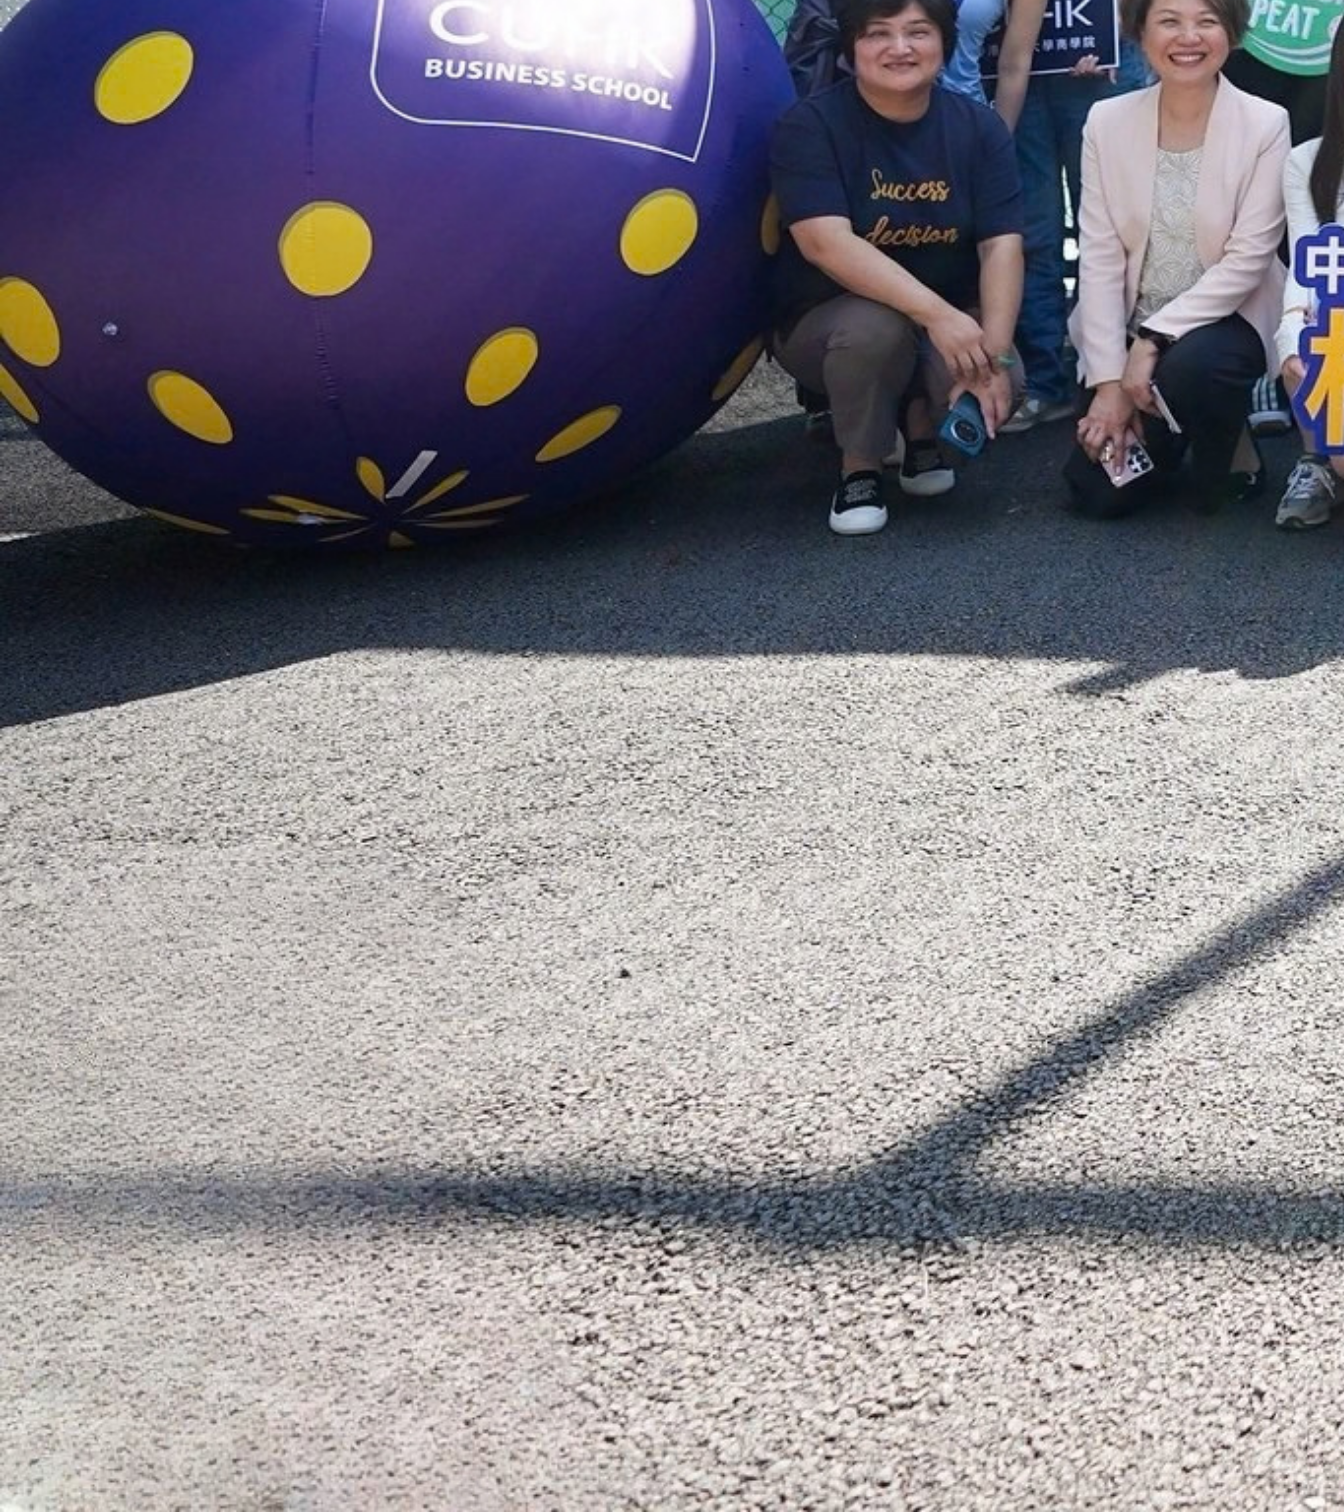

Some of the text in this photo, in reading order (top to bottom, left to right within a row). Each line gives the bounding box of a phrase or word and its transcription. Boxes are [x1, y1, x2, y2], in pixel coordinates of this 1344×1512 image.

[424, 58, 673, 110] BUSINESS SCHOOL
[870, 169, 950, 202] Success
[865, 215, 959, 247] decision
